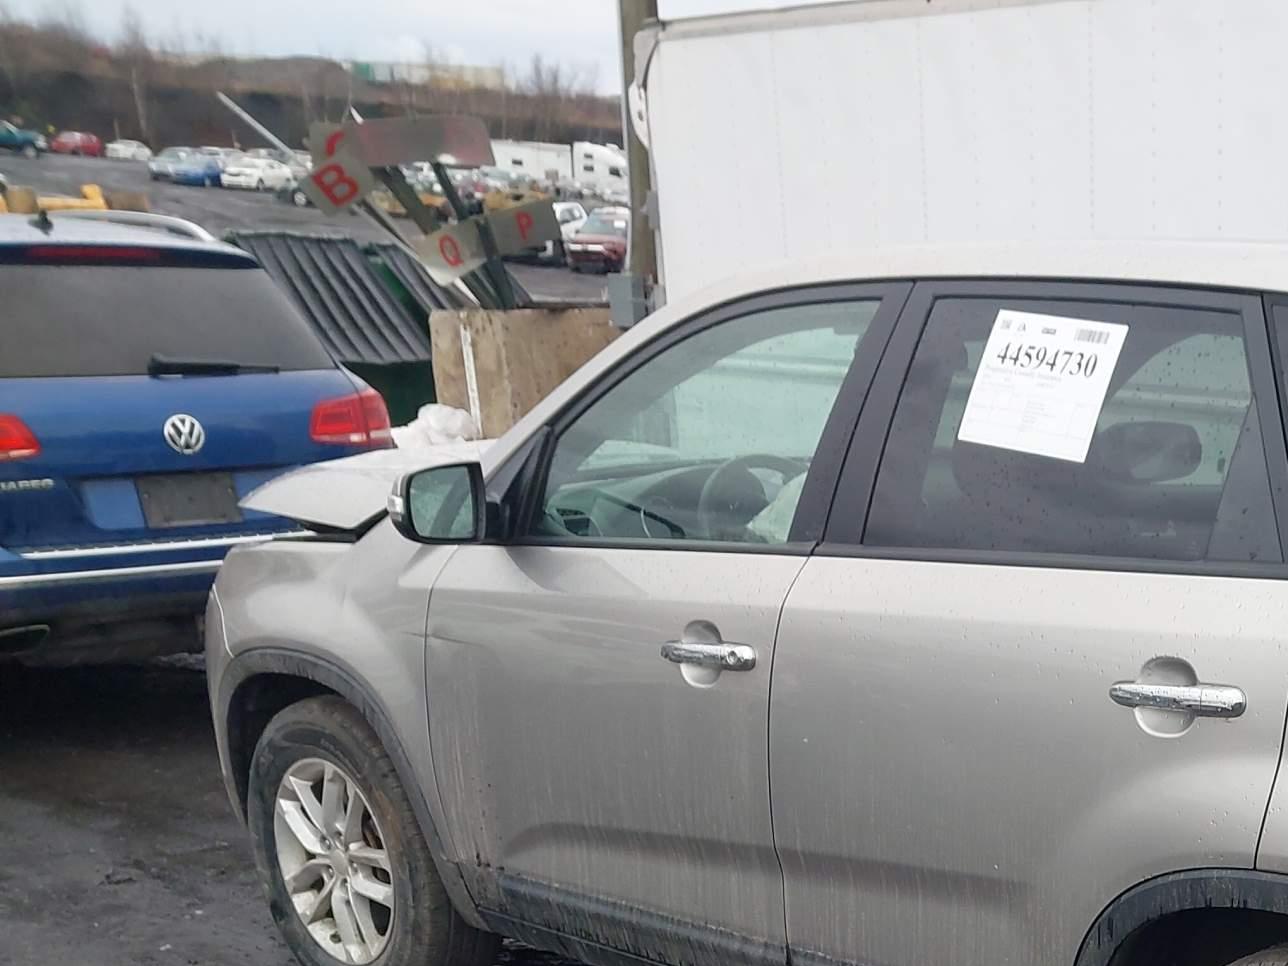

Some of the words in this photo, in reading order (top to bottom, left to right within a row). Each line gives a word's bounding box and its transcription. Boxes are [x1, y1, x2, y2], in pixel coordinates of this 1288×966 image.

[311, 163, 358, 207] B
[515, 211, 534, 240] P
[439, 234, 464, 267] Q
[997, 342, 1098, 378] 44594730
